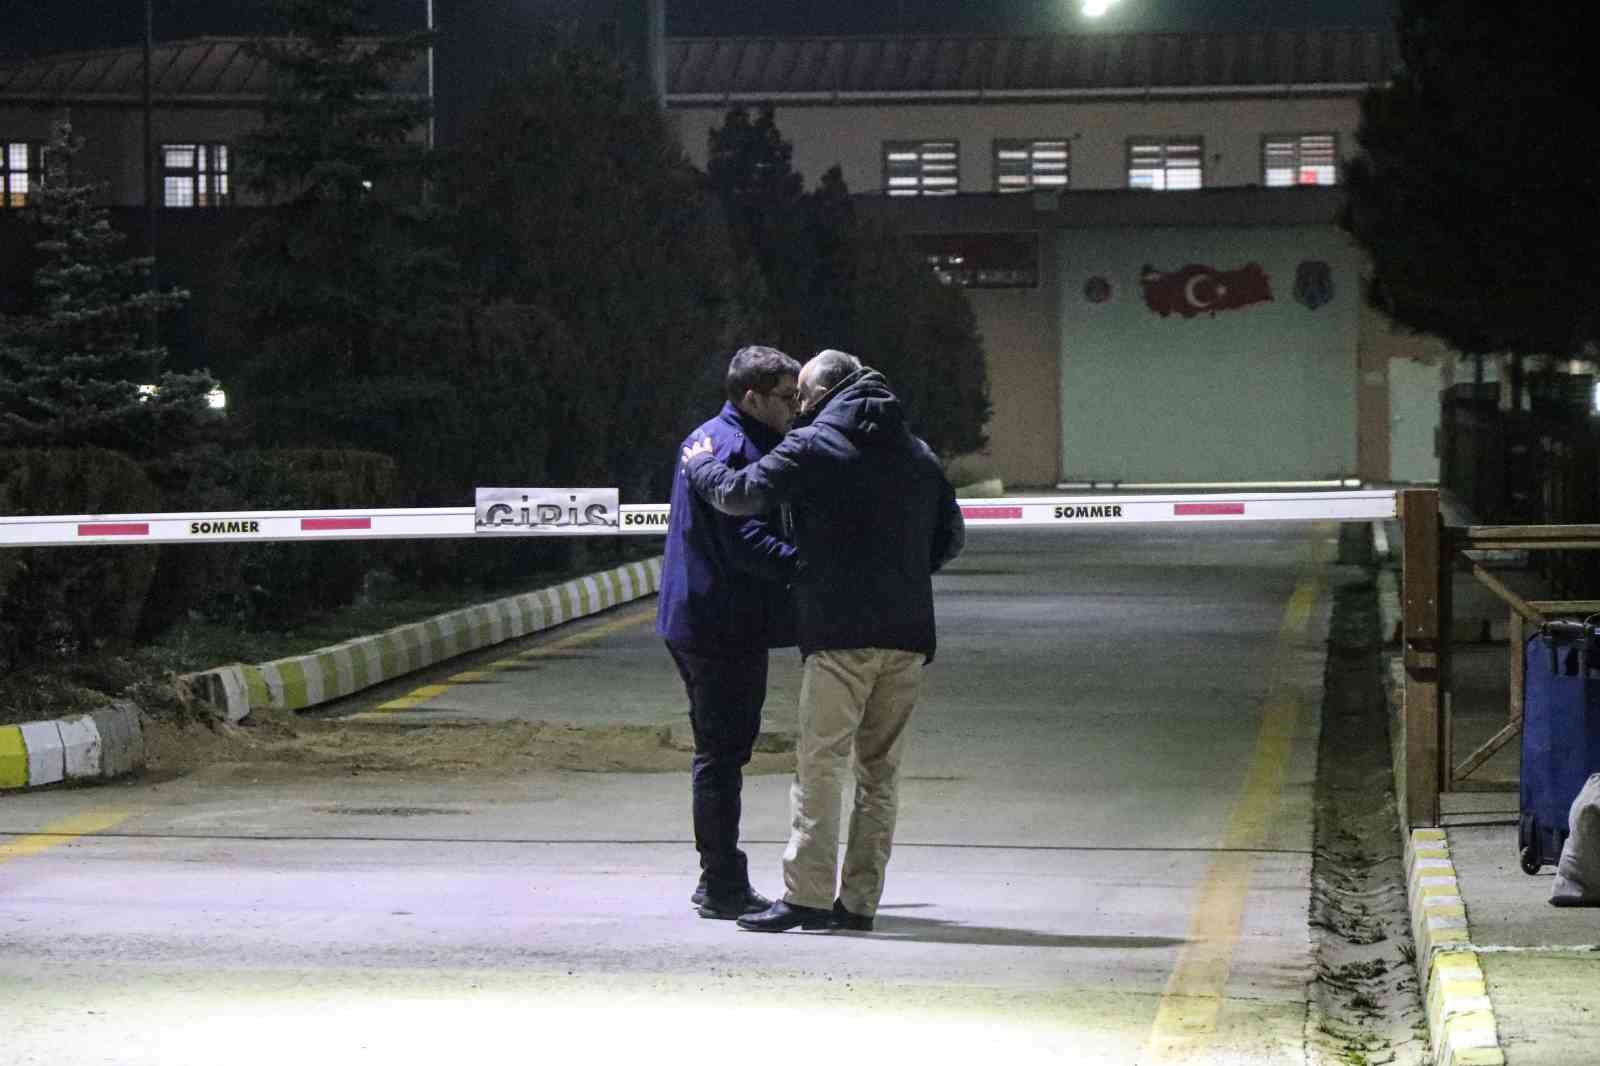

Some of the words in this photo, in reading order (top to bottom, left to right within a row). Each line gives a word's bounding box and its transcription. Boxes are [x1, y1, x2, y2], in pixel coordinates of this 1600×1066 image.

[1054, 505, 1122, 518] SOMMER
[624, 513, 671, 525] SOMM
[191, 521, 259, 534] SOMMER
